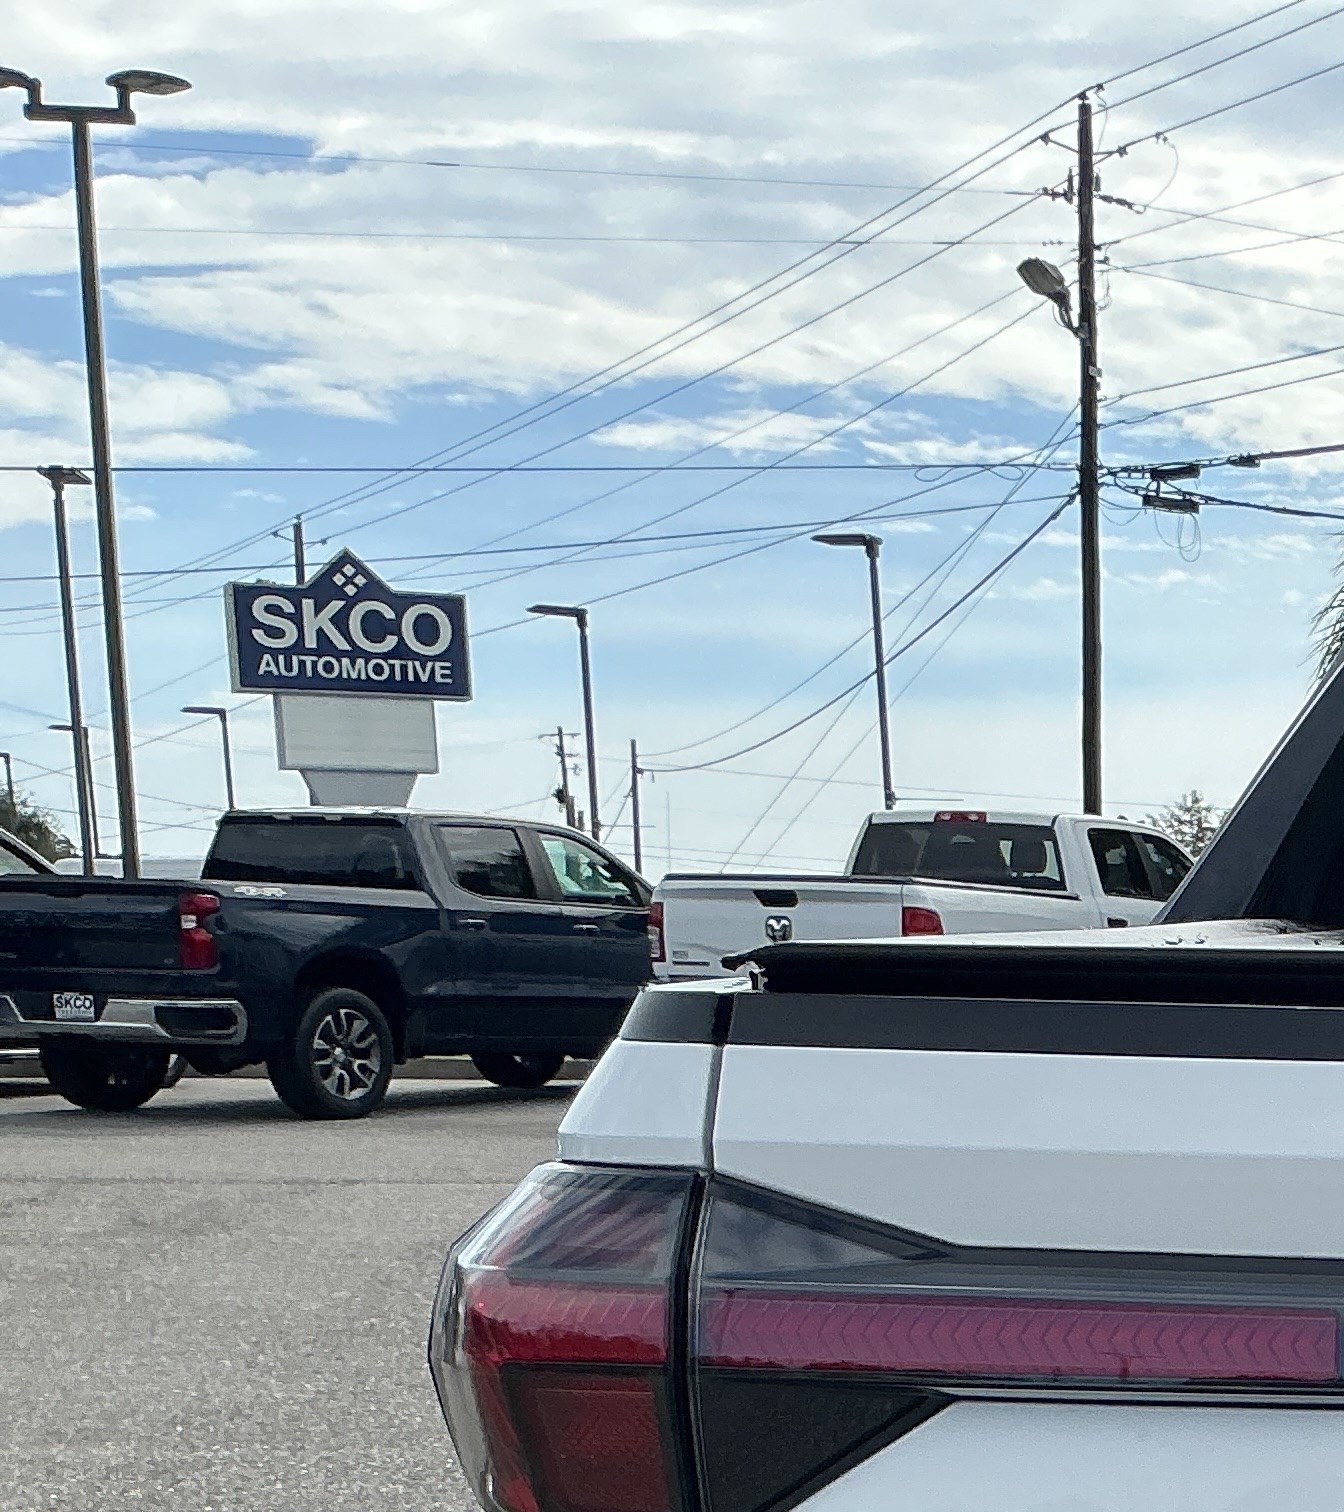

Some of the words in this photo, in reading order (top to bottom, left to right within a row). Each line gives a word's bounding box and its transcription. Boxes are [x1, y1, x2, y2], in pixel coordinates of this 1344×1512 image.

[251, 594, 453, 656] SKCO
[258, 653, 453, 684] AUTOMOTIVE
[55, 995, 93, 1009] SKCO
